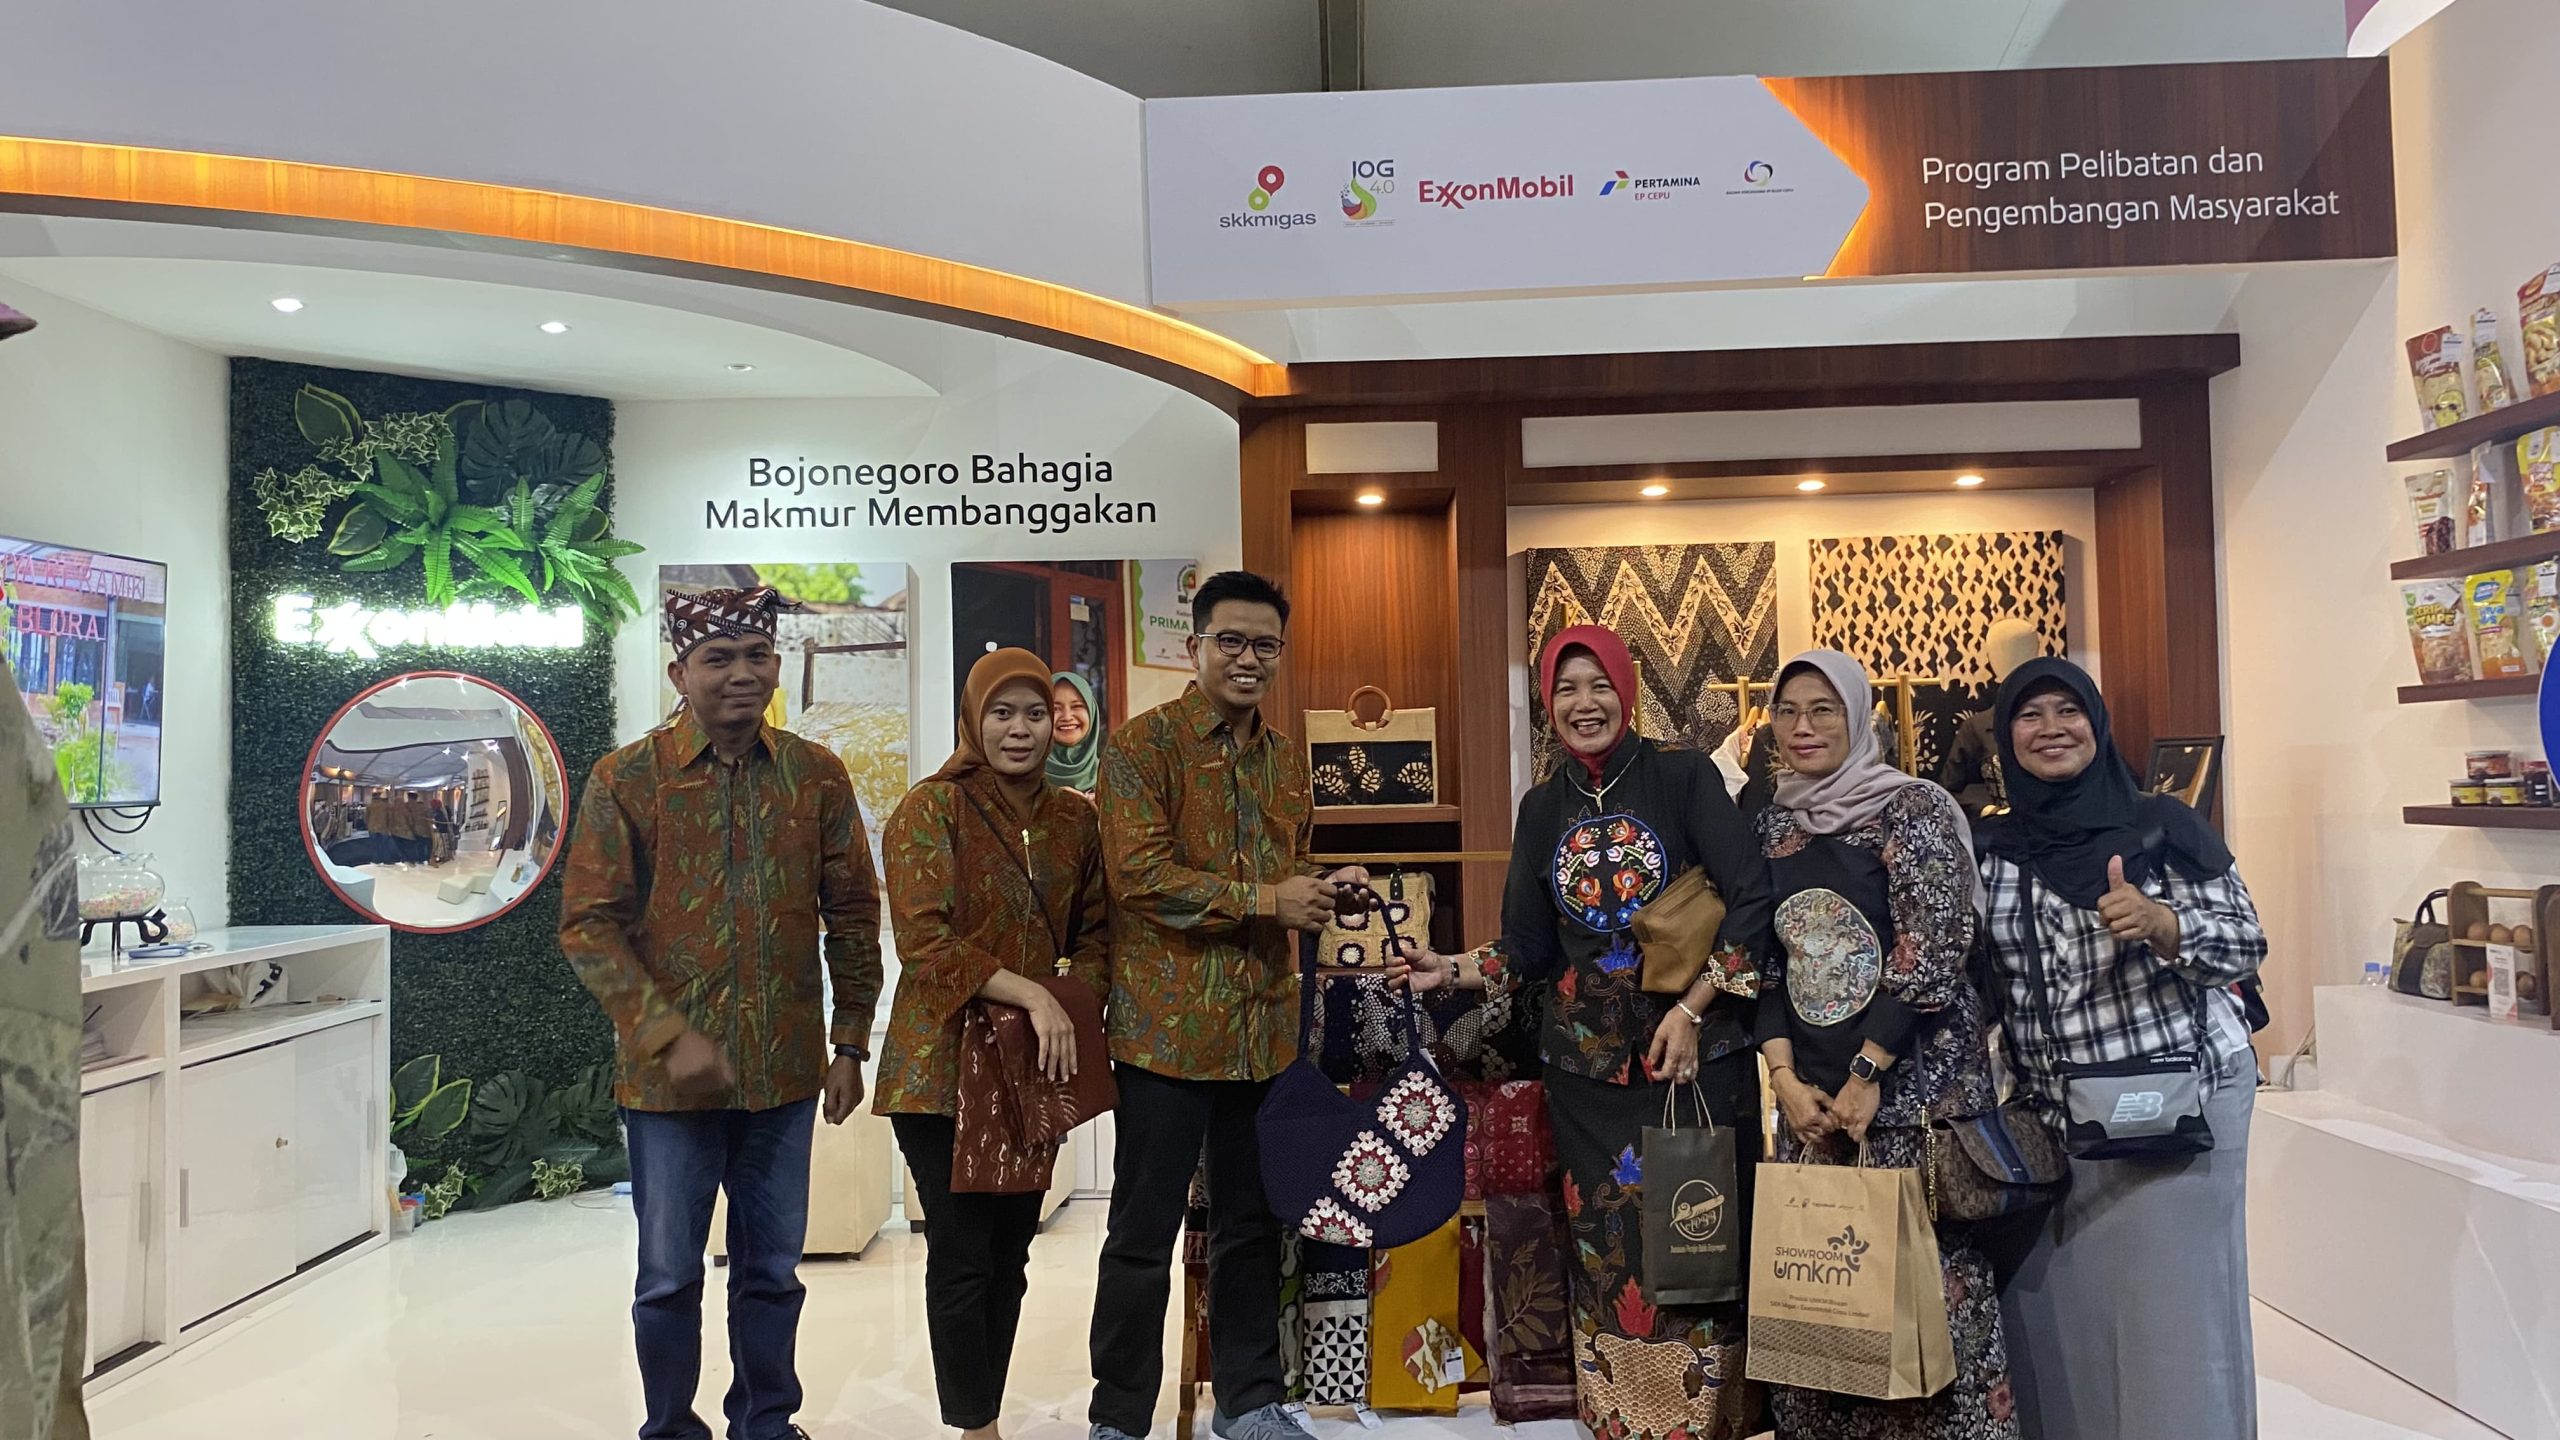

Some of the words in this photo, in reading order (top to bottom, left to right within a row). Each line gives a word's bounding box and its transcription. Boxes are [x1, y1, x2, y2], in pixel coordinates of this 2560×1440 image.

[1922, 154, 2050, 189] Program
[2060, 149, 2198, 180] Pelibatan
[2208, 145, 2263, 175] dan
[1369, 179, 1395, 194] 4.0
[1418, 174, 1574, 210] ExxonMobil
[1634, 176, 1701, 189] PERTAMINA
[1634, 192, 1646, 201] EP
[1647, 191, 1671, 200] CEPU
[1219, 211, 1317, 230] skkmigas
[1924, 195, 2159, 233] Pengembangan
[2170, 187, 2340, 225] Masyarakat
[748, 456, 959, 495] Bojonegoro
[970, 452, 1114, 492] Bahagia
[705, 497, 857, 530] Makmur
[867, 493, 1158, 534] Membanggakan
[17, 604, 100, 642] BLORA
[1149, 615, 1190, 631] PRIMA
[1775, 1246, 1844, 1262] SHOWROOM
[1773, 1260, 1852, 1287] umkm
